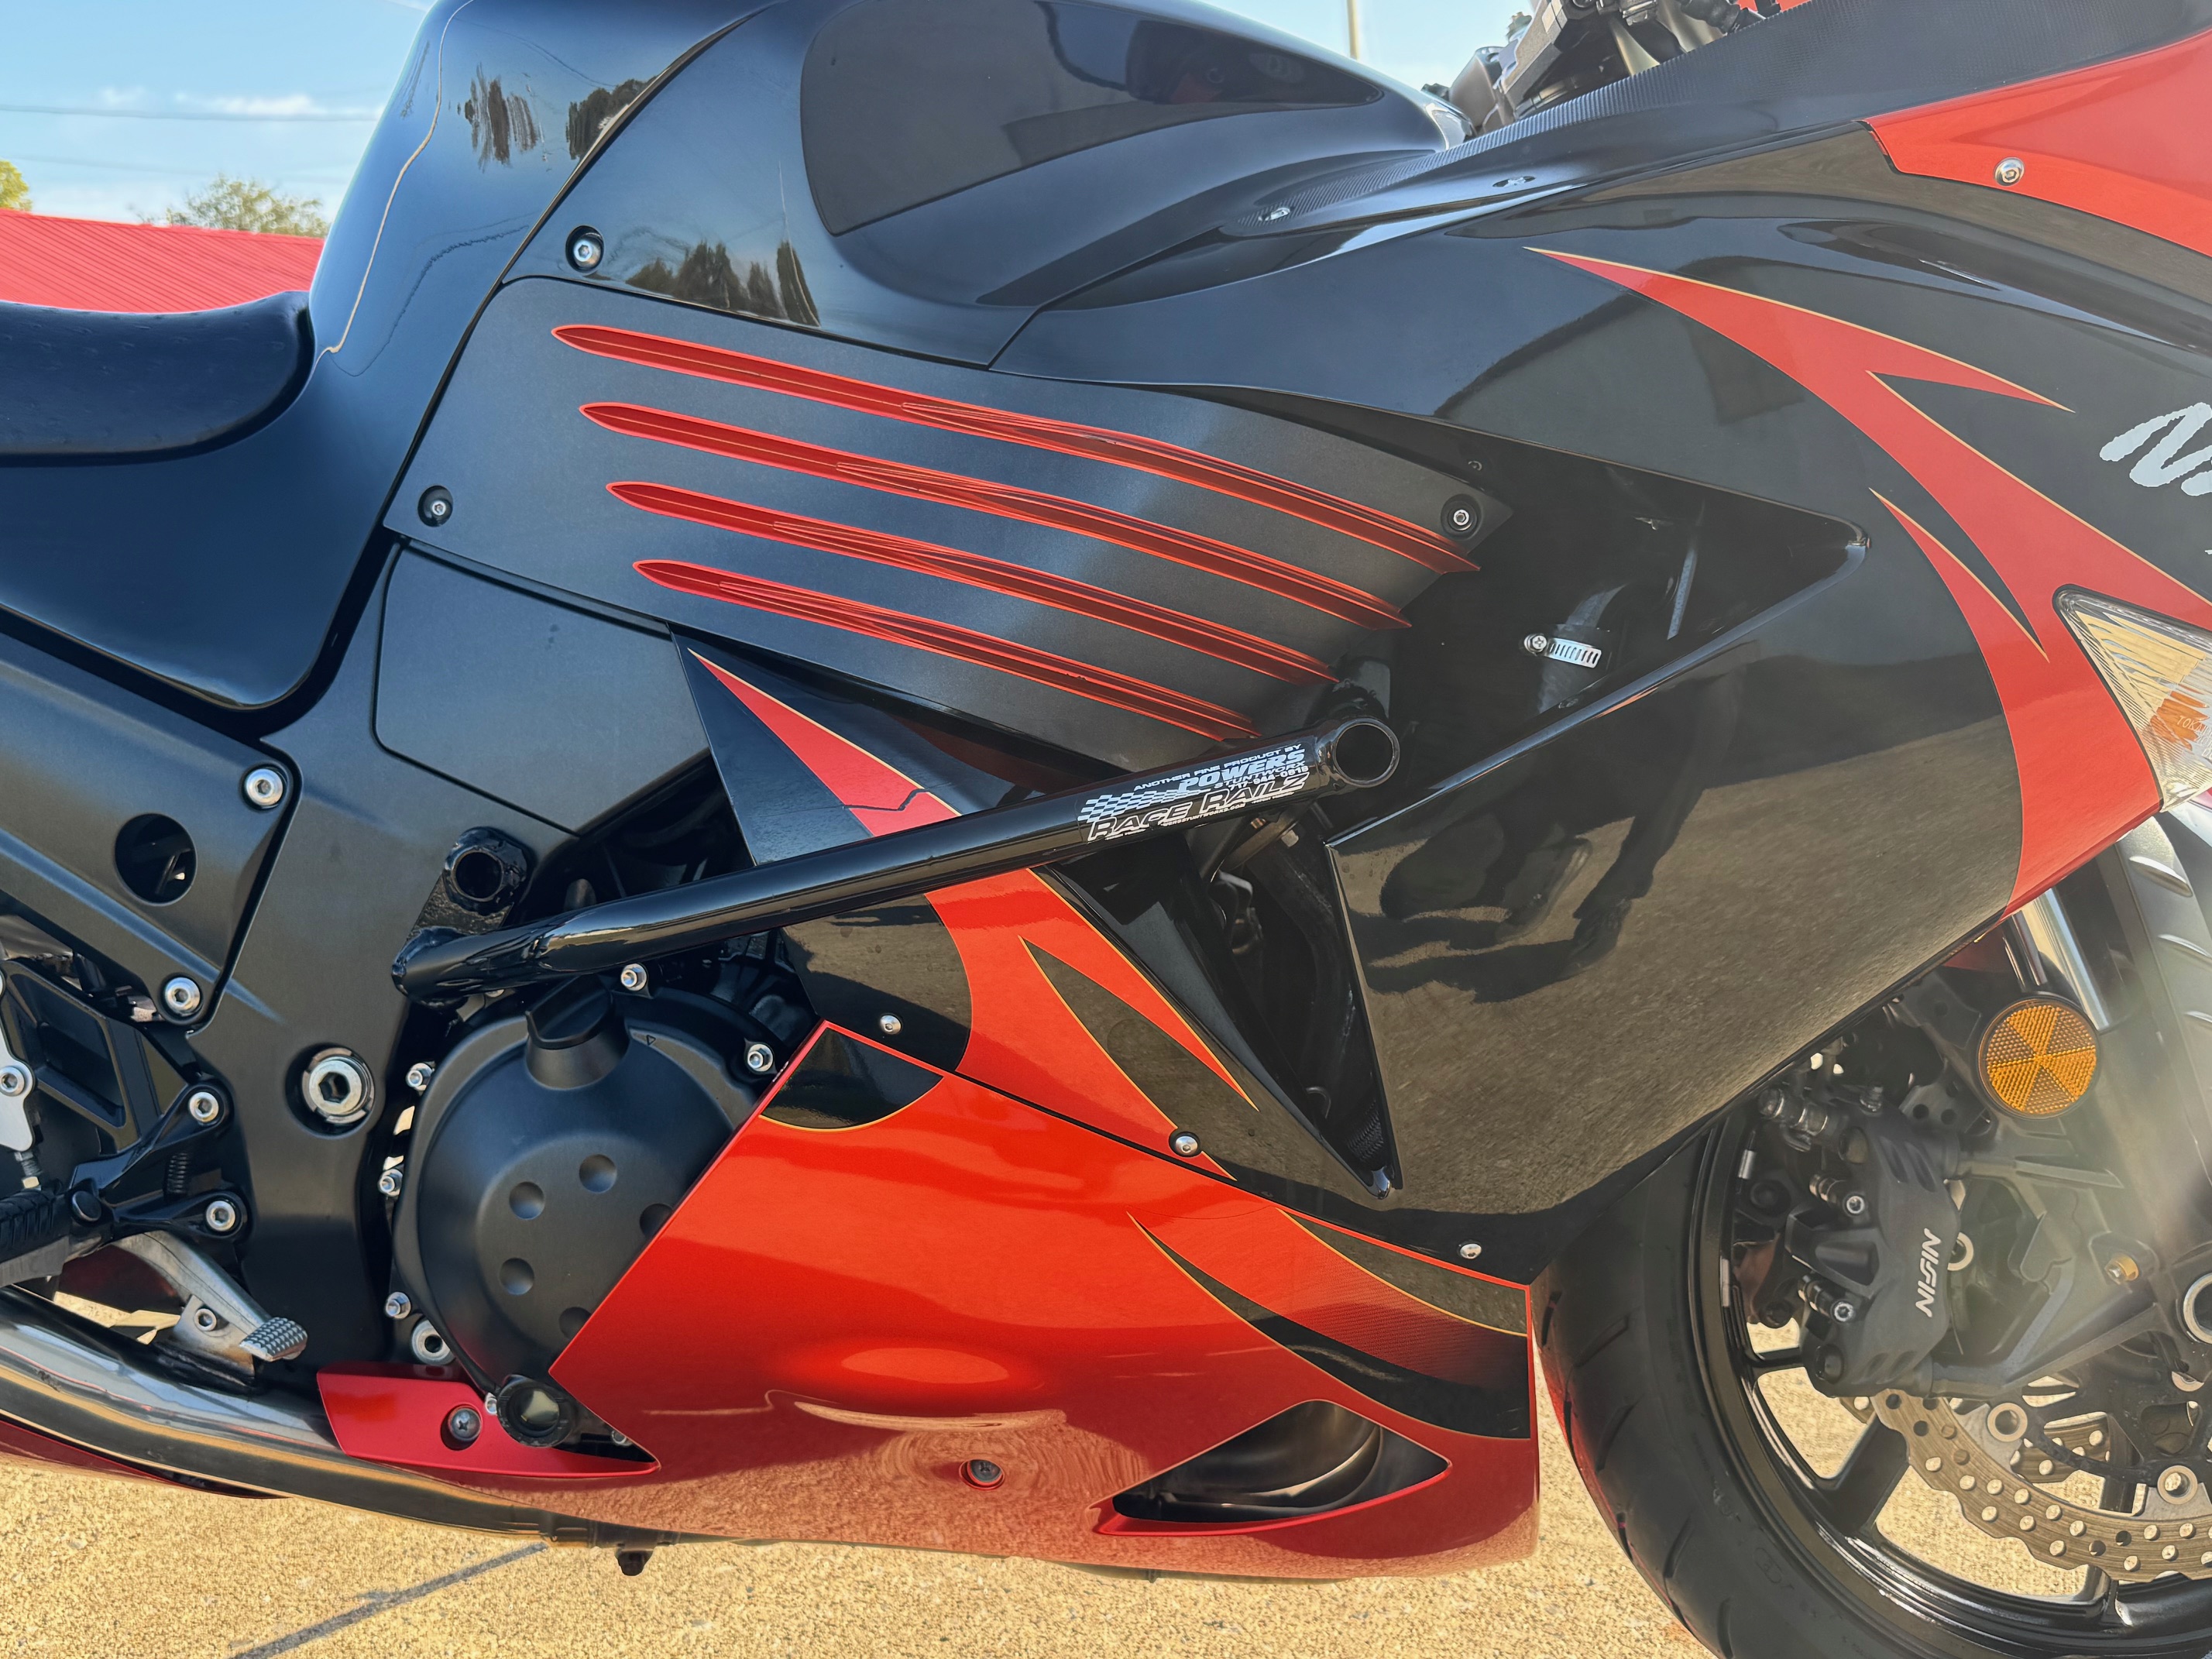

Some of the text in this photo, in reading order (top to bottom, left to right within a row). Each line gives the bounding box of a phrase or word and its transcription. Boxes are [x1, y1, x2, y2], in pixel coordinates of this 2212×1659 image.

[1133, 744, 1302, 791] ANOTHER FINE PRODUCT BY
[1176, 748, 1306, 794] POWERS
[1214, 761, 1306, 789] STUNTWORX
[1087, 771, 1310, 843] RACE RAILZ
[1915, 1228, 1942, 1317] NISSIN
